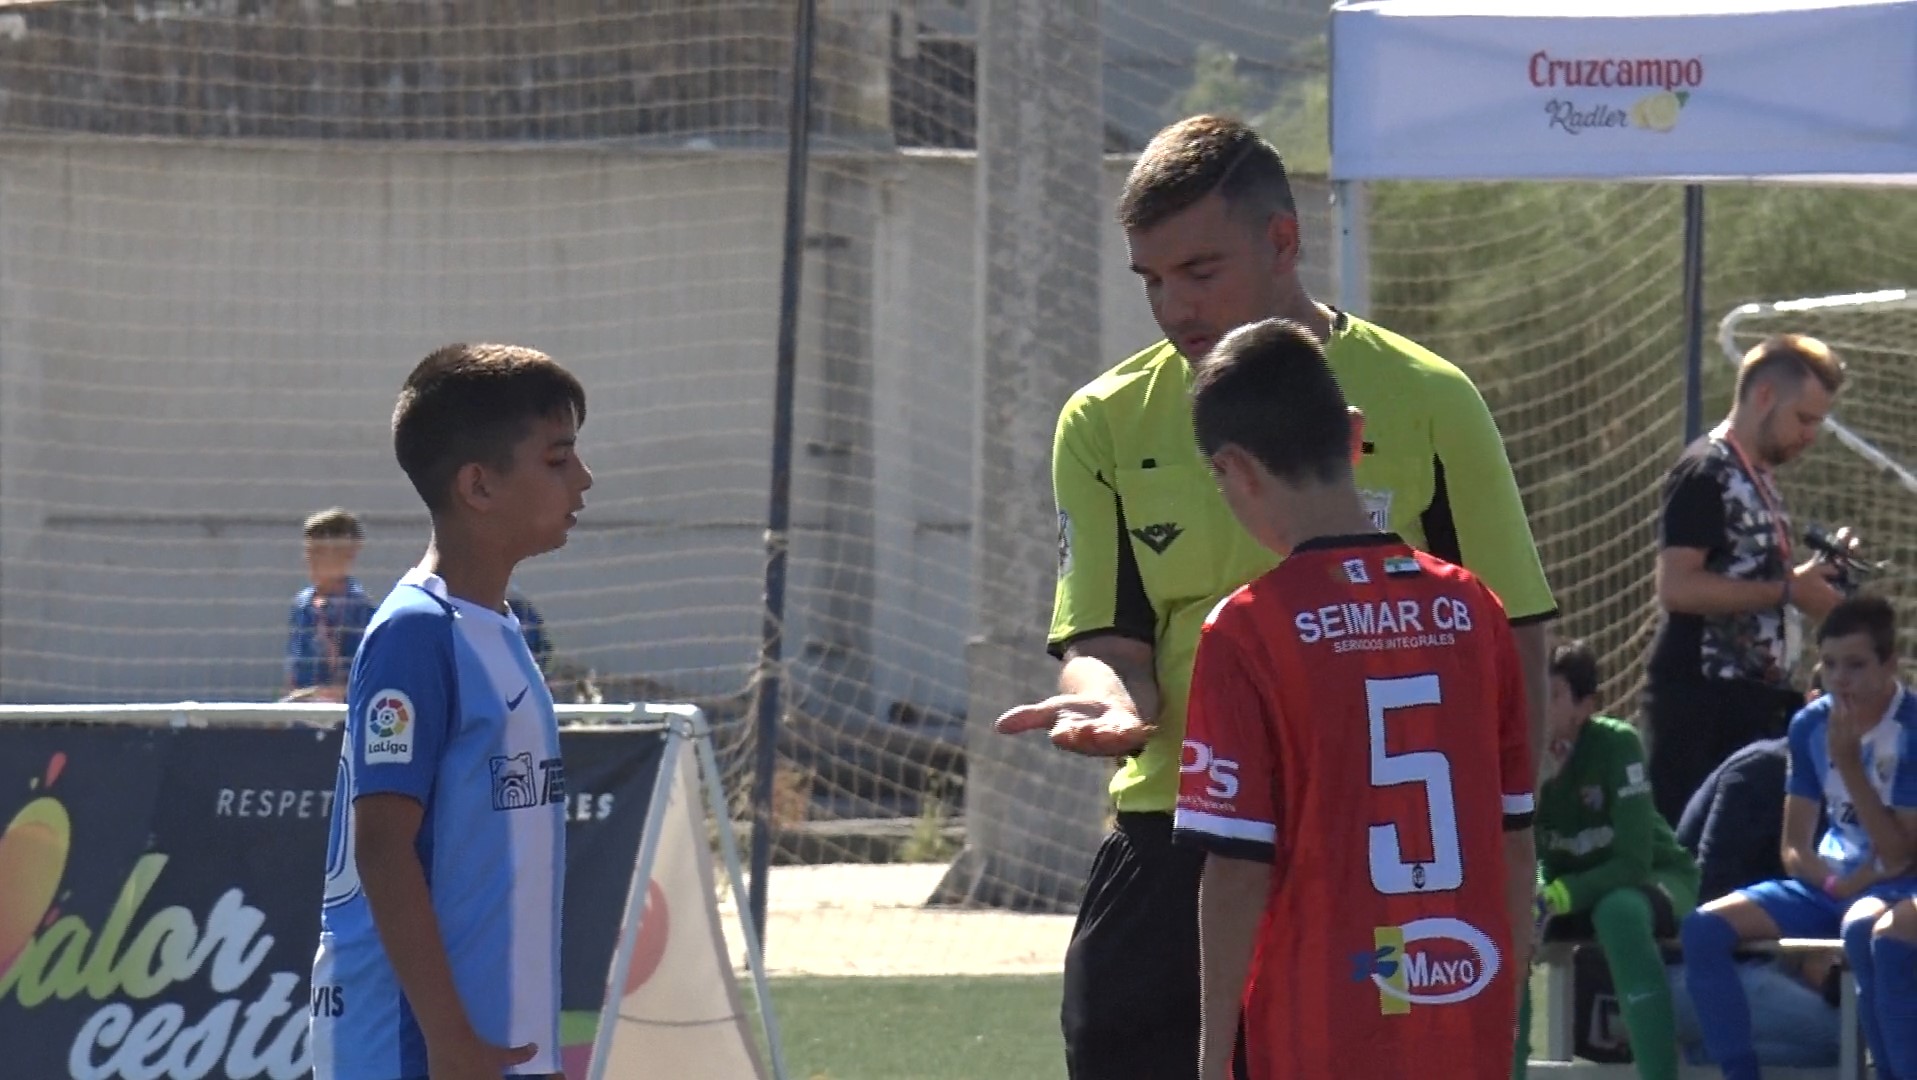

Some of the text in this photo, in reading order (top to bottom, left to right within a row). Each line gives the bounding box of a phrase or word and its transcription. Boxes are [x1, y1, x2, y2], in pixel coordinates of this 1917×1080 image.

[1529, 51, 1703, 91] Cruzcampo
[1545, 99, 1629, 135] Radler
[1295, 597, 1473, 643] SEIMAR CB
[1384, 632, 1455, 649] INTEGRALES
[368, 740, 407, 755] LaLiga
[1365, 673, 1464, 894] 5
